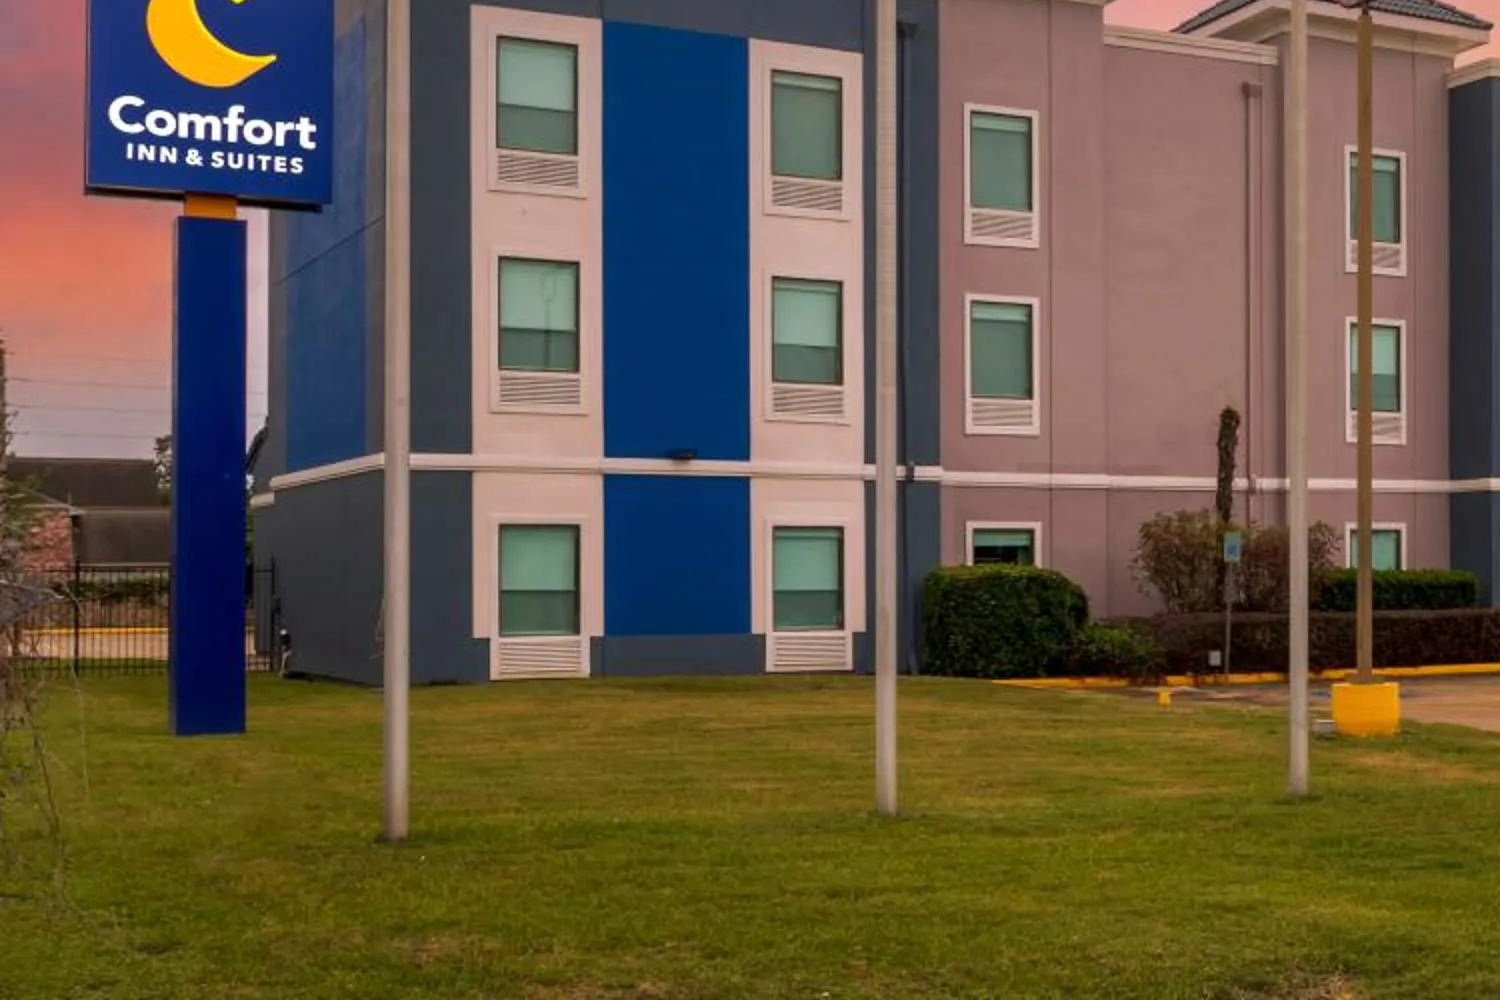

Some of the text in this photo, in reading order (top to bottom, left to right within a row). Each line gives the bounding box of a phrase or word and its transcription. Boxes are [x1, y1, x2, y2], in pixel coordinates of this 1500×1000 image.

[107, 95, 317, 150] Comfort
[126, 143, 304, 174] INN & SUITES
